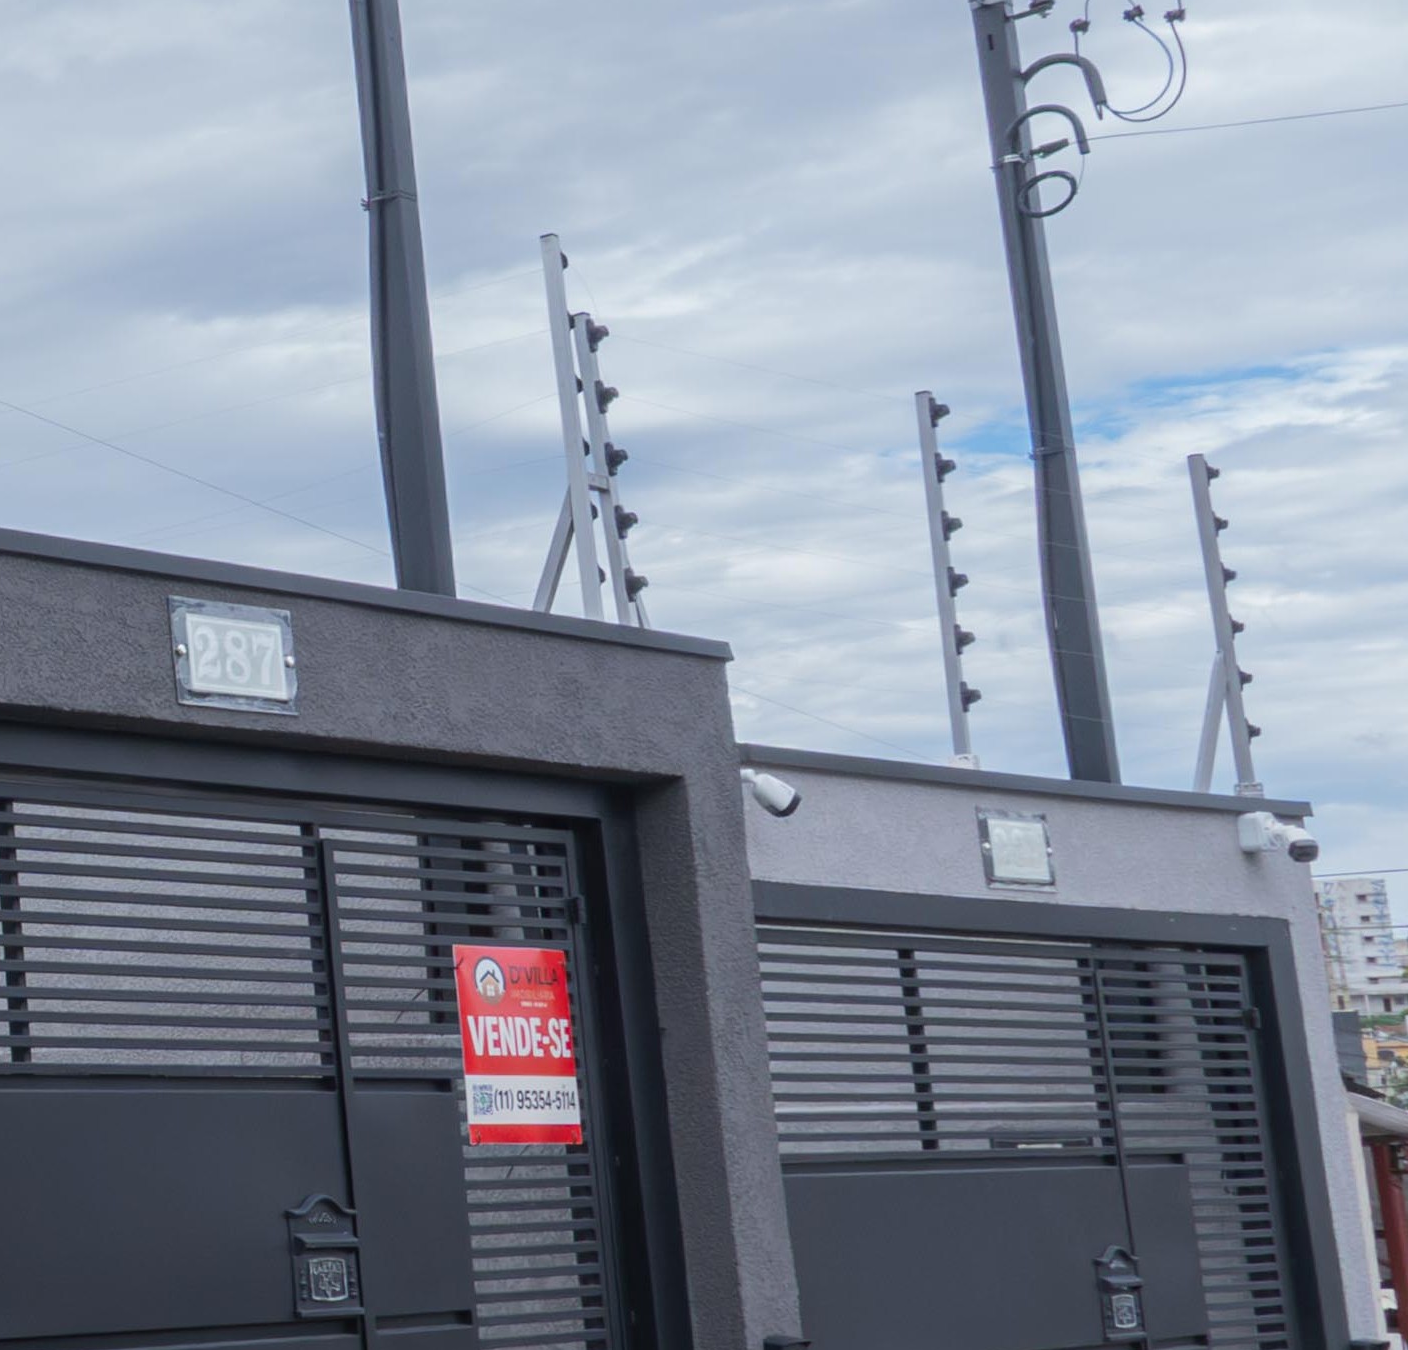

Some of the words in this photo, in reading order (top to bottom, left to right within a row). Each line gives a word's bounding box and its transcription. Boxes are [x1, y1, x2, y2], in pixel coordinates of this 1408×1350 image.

[194, 625, 275, 685] 287
[467, 1016, 571, 1058] VENDE-SE
[494, 1088, 514, 1111] (11)
[516, 1090, 576, 1110] 95354-5114
